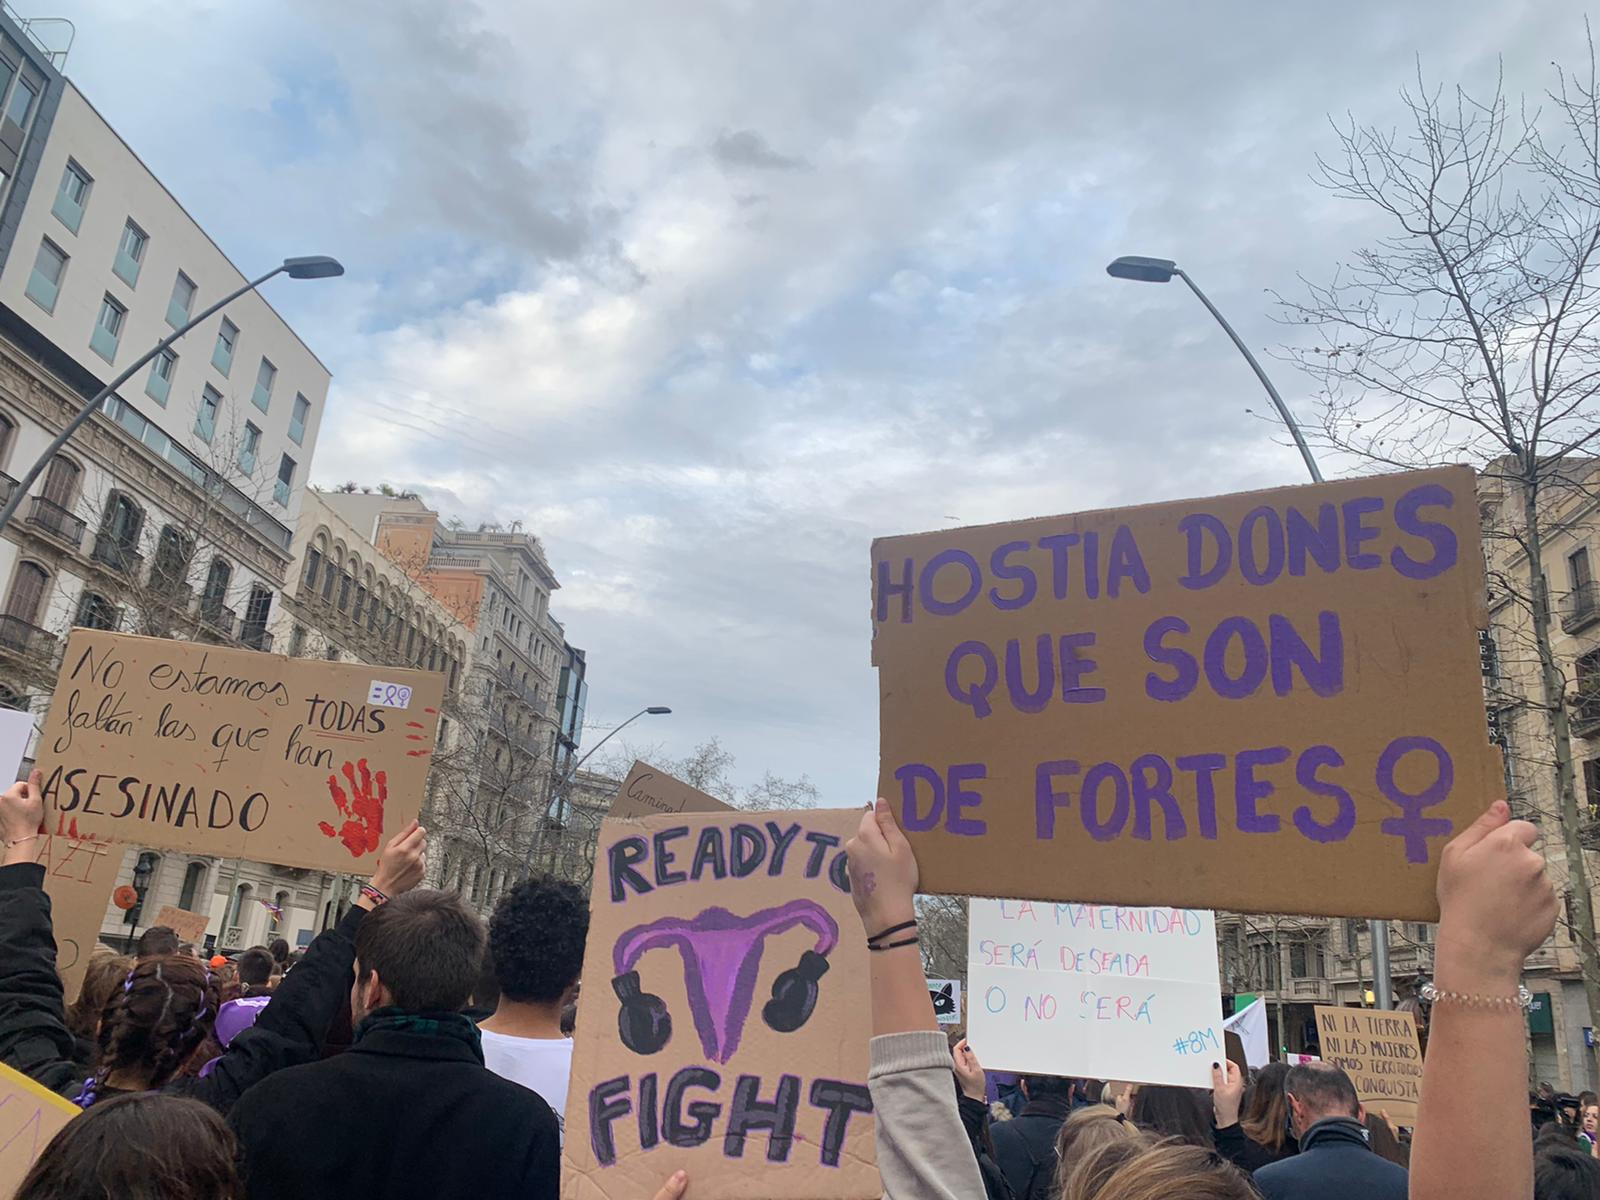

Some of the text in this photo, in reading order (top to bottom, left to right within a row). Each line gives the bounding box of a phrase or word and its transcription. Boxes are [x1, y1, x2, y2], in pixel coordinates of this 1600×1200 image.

[876, 484, 1459, 623] HOSTIA DONES
[149, 651, 289, 706] estamos
[305, 694, 386, 733] TODAS
[945, 610, 1344, 719] QUE SON
[54, 689, 333, 773] faltan las que han
[41, 765, 270, 832] ASESINADO
[895, 746, 1355, 843] DE FORTES
[607, 822, 801, 902] READY
[1000, 899, 1201, 936] LA MATERNIDAD
[979, 940, 1150, 977] SERÁ DESEADA
[985, 986, 1157, 1025] O NO SERÁ
[1321, 1014, 1413, 1038] NI LA TIERRA
[1172, 1027, 1220, 1056] #8M
[1326, 1036, 1418, 1060] NI LAS MUJERES
[588, 1065, 874, 1169] FIGHT
[1354, 1075, 1419, 1098] CONQUISTA
